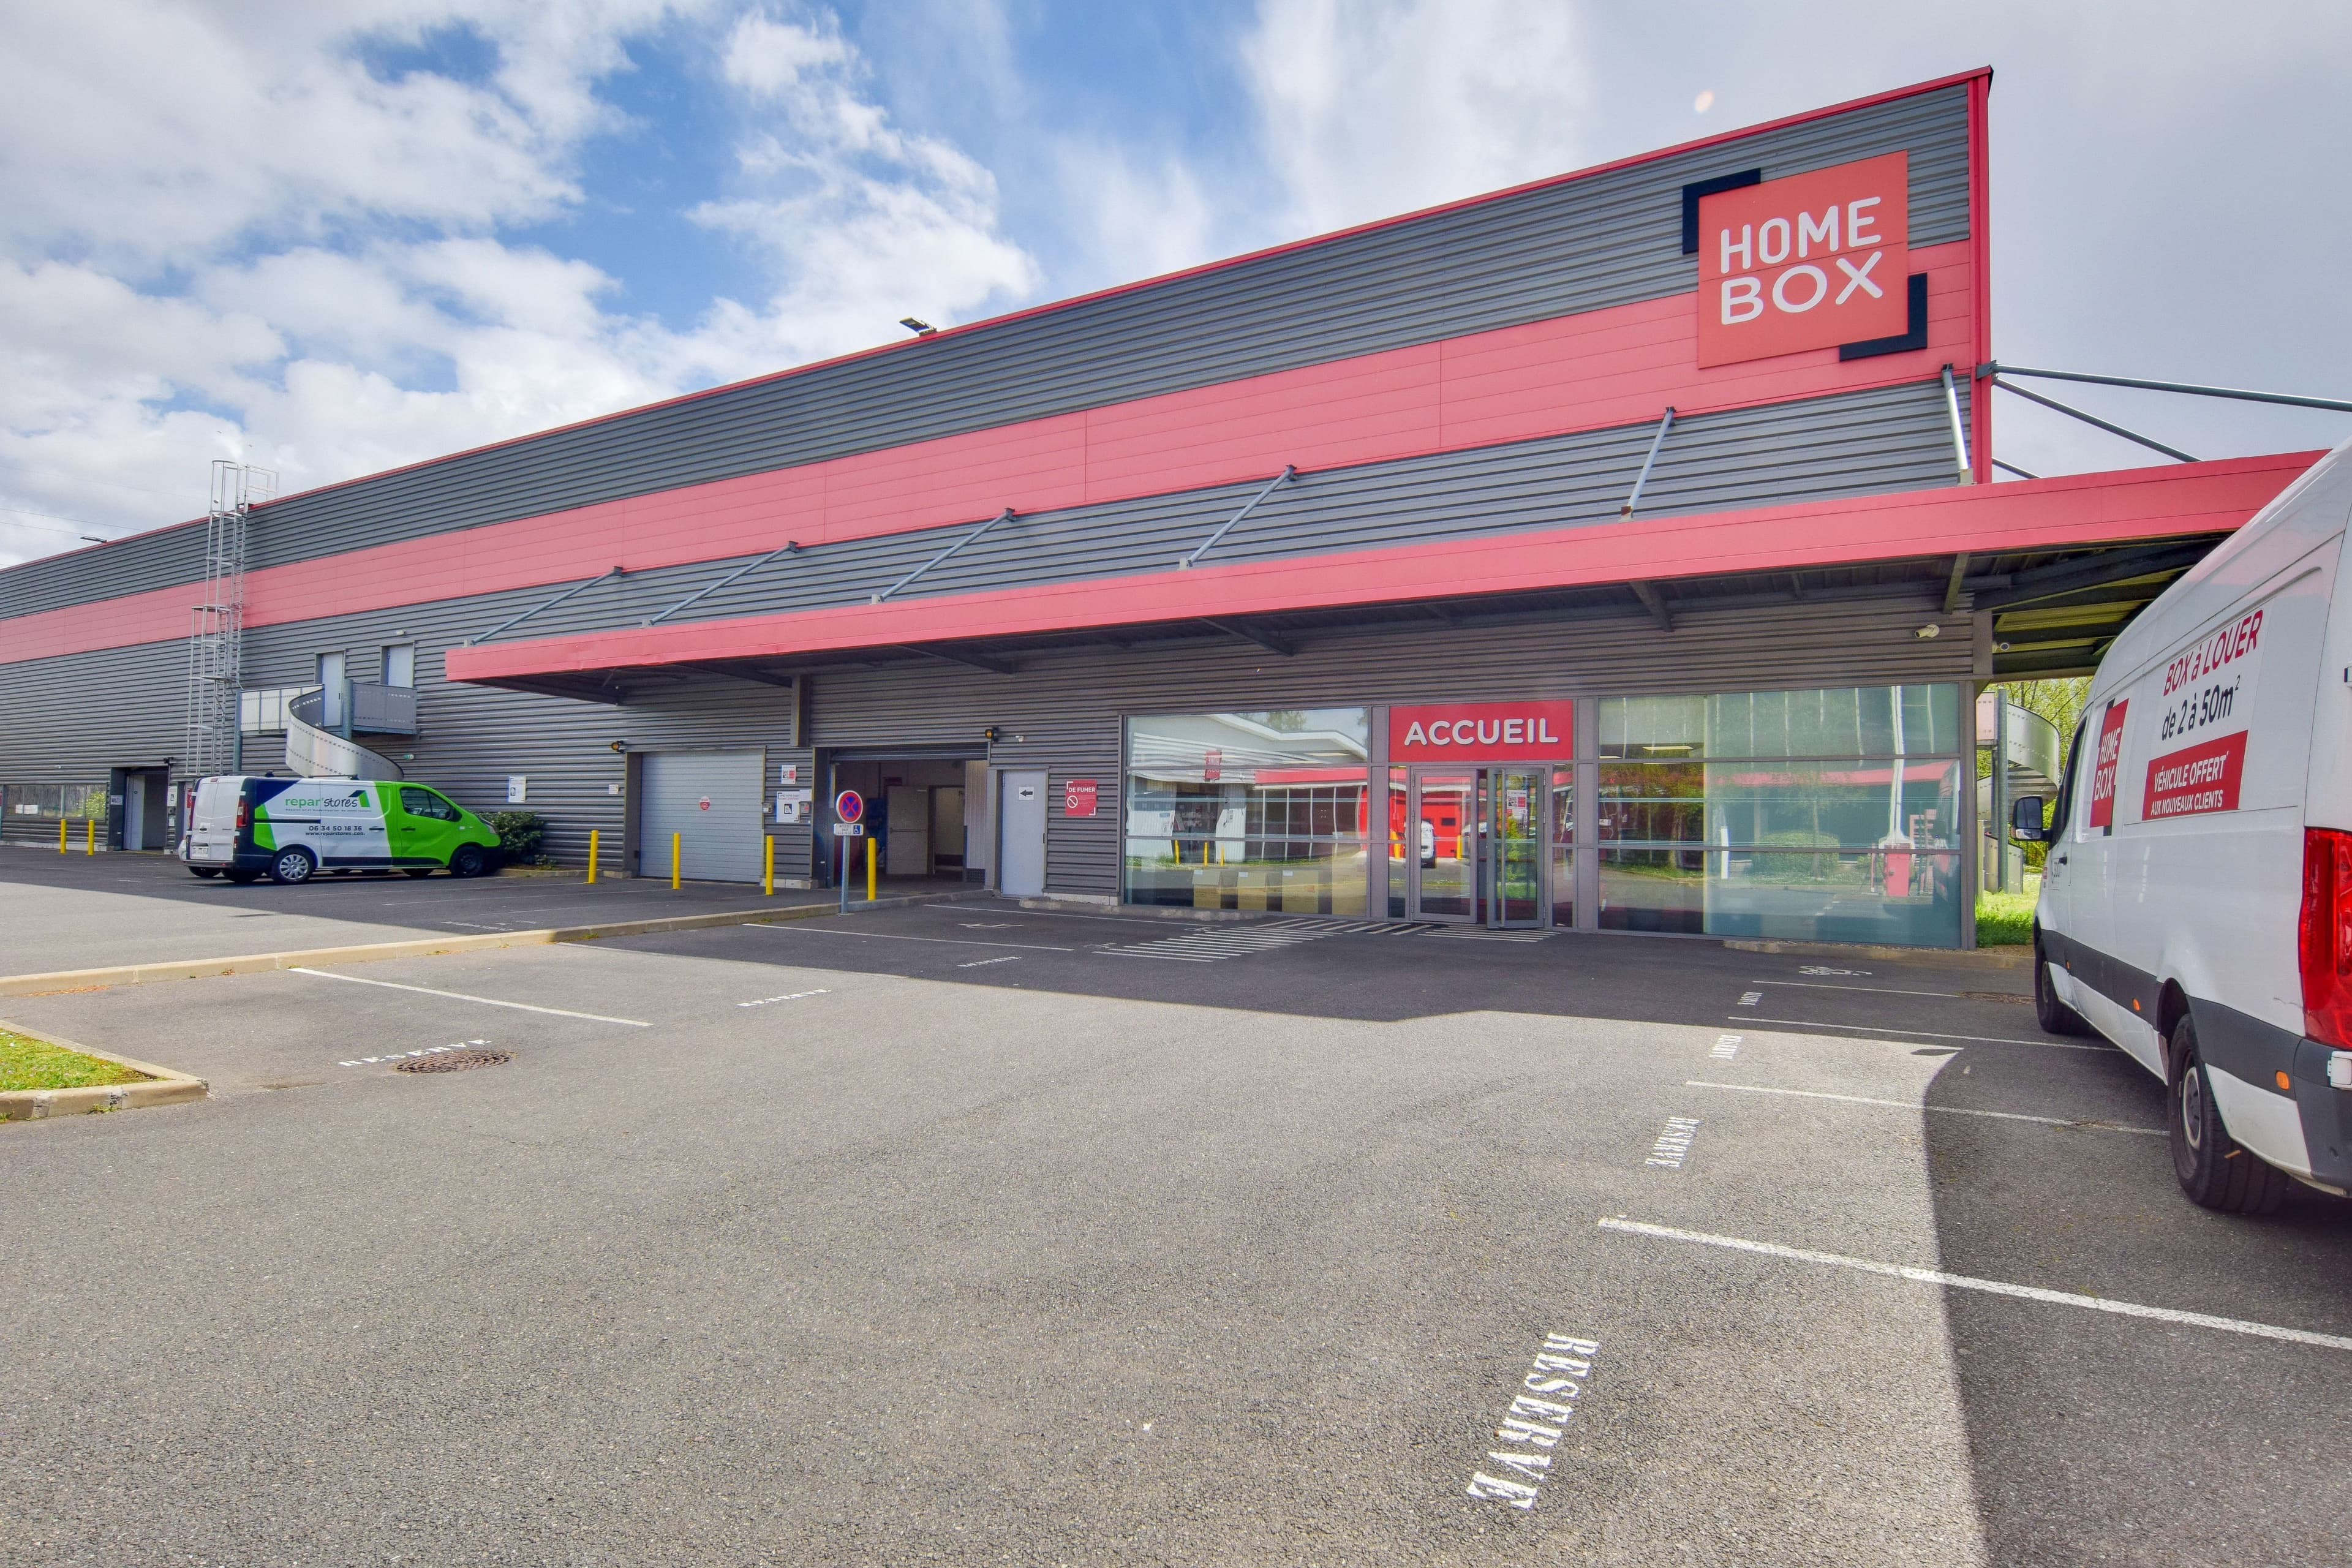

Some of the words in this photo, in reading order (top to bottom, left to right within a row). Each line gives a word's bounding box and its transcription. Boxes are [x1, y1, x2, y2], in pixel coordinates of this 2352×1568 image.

[1721, 196, 1881, 274] HOME
[1721, 251, 1883, 325] BOX
[2163, 651, 2193, 696] BOX
[2191, 644, 2203, 681] à
[2202, 609, 2264, 675] LOUER
[1404, 718, 1559, 745] ACCUEIL
[2162, 706, 2176, 741] de
[2177, 699, 2188, 735] 2
[2188, 693, 2197, 731] à
[2099, 727, 2121, 766] HOME
[2094, 764, 2115, 801] BOX
[2154, 764, 2189, 793] VÉHICULE
[2151, 801, 2162, 815] AUX
[2162, 795, 2193, 814] NOUVEAUX
[2194, 790, 2223, 810] CLIENTS
[1466, 1332, 1600, 1510] RESERVE
